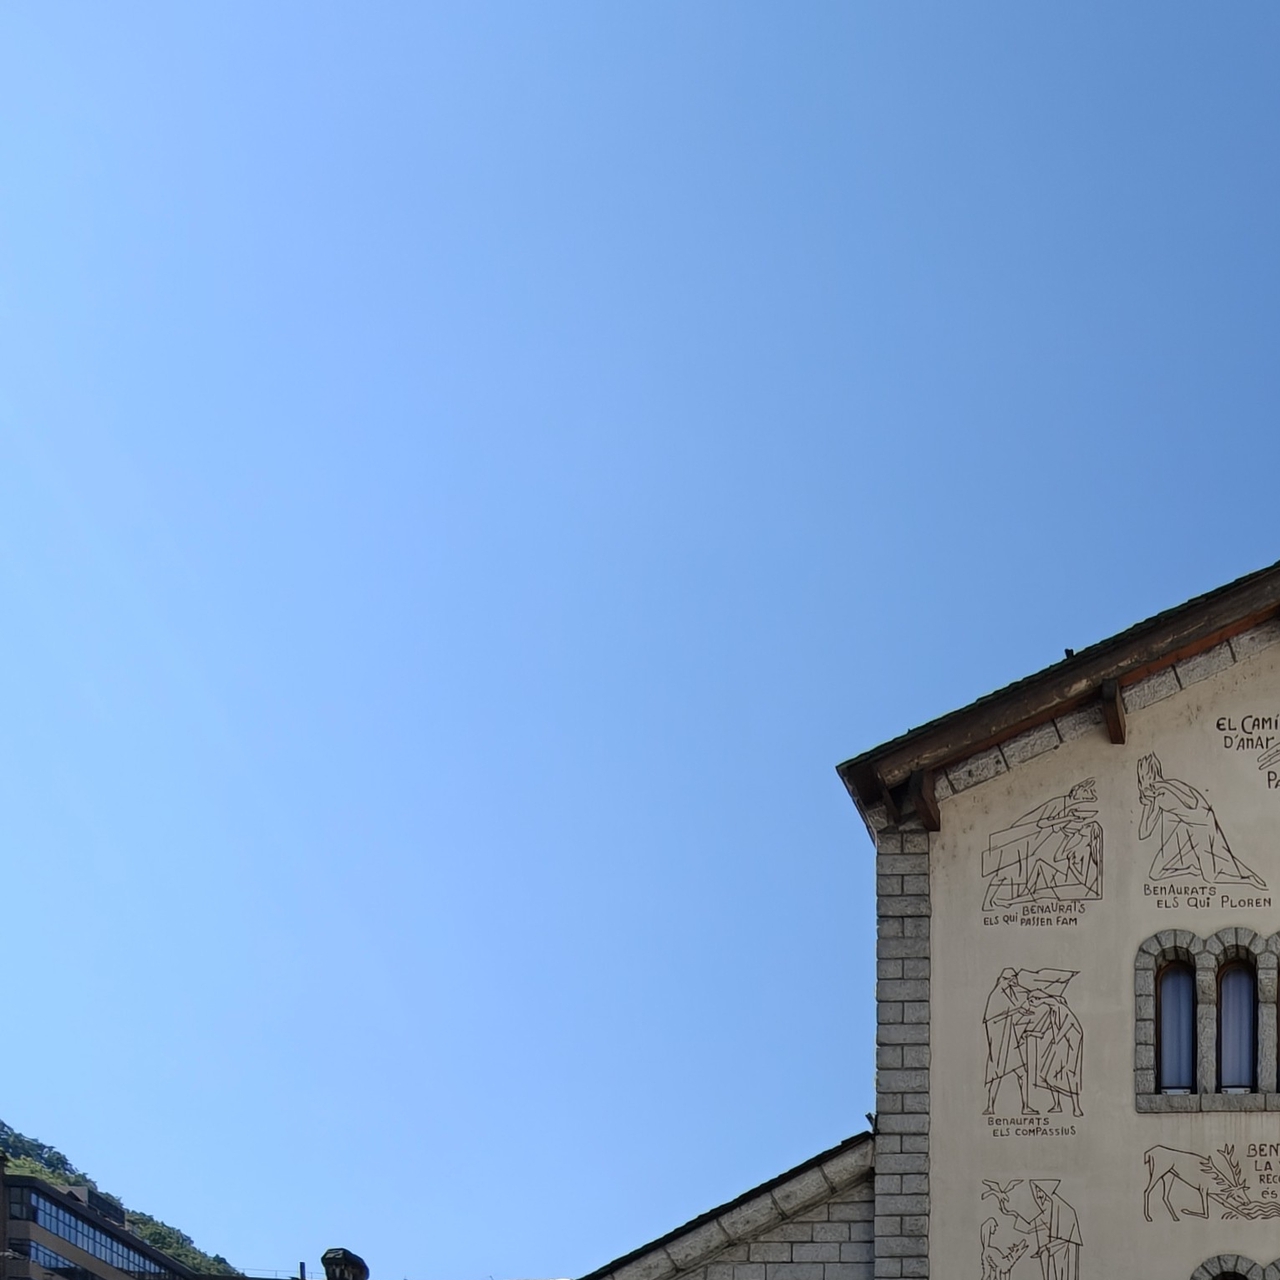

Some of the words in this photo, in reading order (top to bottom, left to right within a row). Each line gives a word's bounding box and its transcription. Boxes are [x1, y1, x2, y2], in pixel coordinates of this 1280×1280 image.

[1241, 714, 1280, 735] CAMÍ
[1022, 901, 1086, 916] BENAURATS
[1156, 897, 1180, 909] ELS
[1221, 896, 1272, 909] PLOREN
[983, 915, 999, 926] ELS
[1056, 916, 1078, 926] FAM
[992, 1128, 1011, 1137] ELS
[1254, 1160, 1273, 1172] LA
